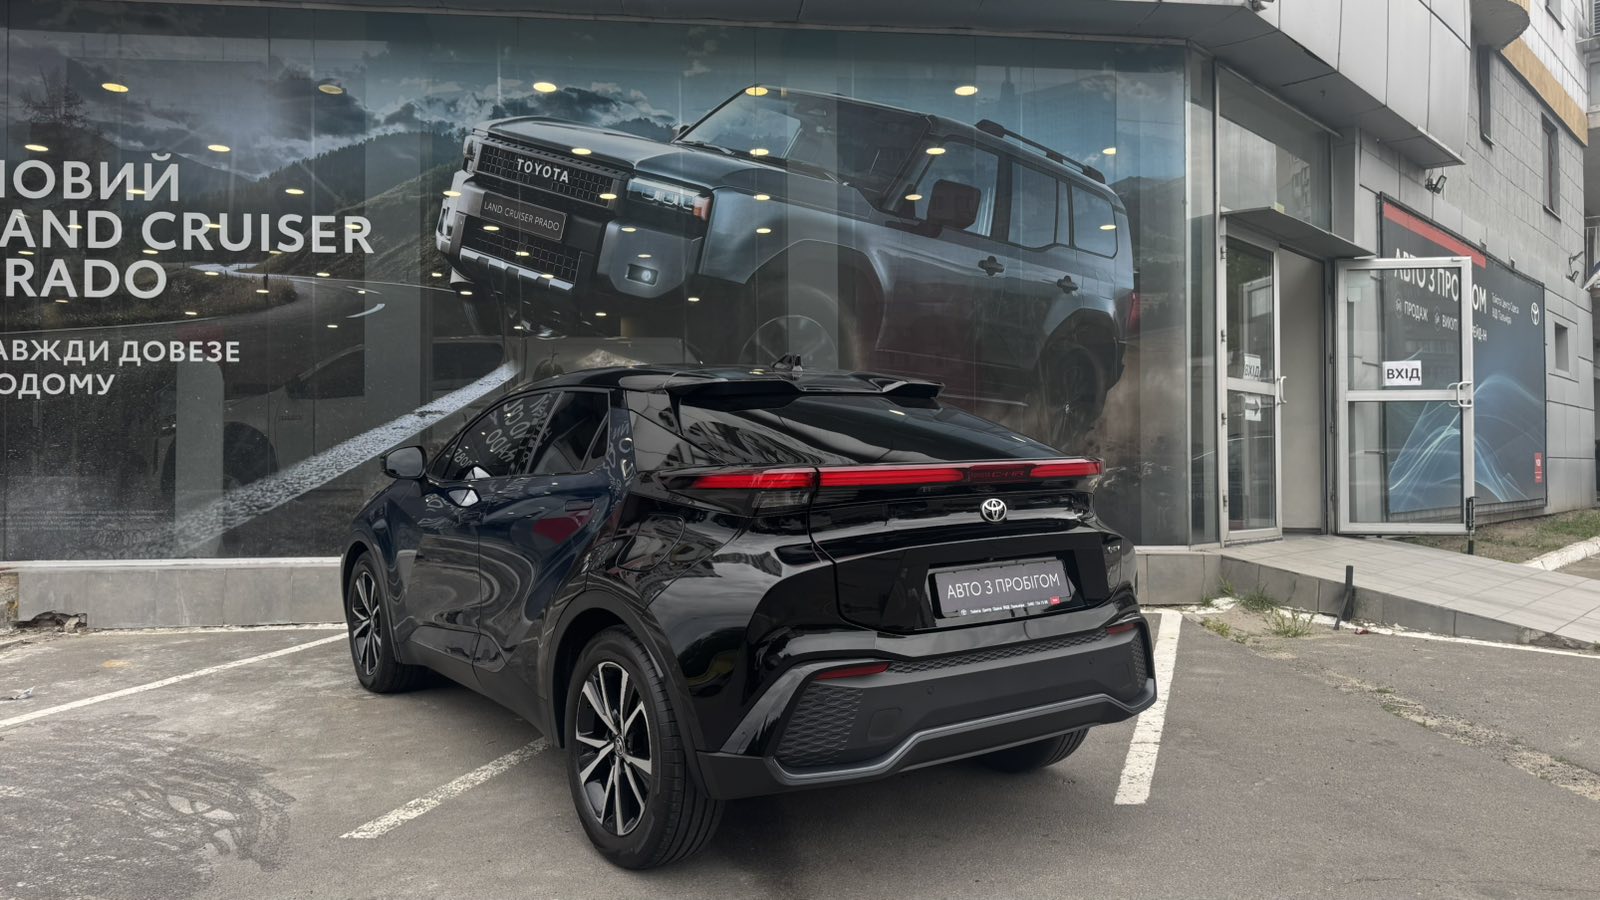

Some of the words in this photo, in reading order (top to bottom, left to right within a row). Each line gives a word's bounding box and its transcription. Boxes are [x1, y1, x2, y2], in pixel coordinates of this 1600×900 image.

[0, 153, 179, 202] ОВИЙ
[517, 158, 569, 184] TOYOTA
[484, 201, 503, 214] LAND
[504, 207, 533, 223] CRUISER
[534, 216, 560, 231] PRADO
[141, 211, 375, 254] CRUISER
[5, 258, 167, 299] RADO
[118, 341, 241, 366] ДОВЕЗЕ
[0, 373, 115, 399] ОДОМУ
[1386, 367, 1421, 382] ВХІД
[947, 581, 982, 599] АВТО
[995, 573, 1061, 593] ПРОБІГОМ
